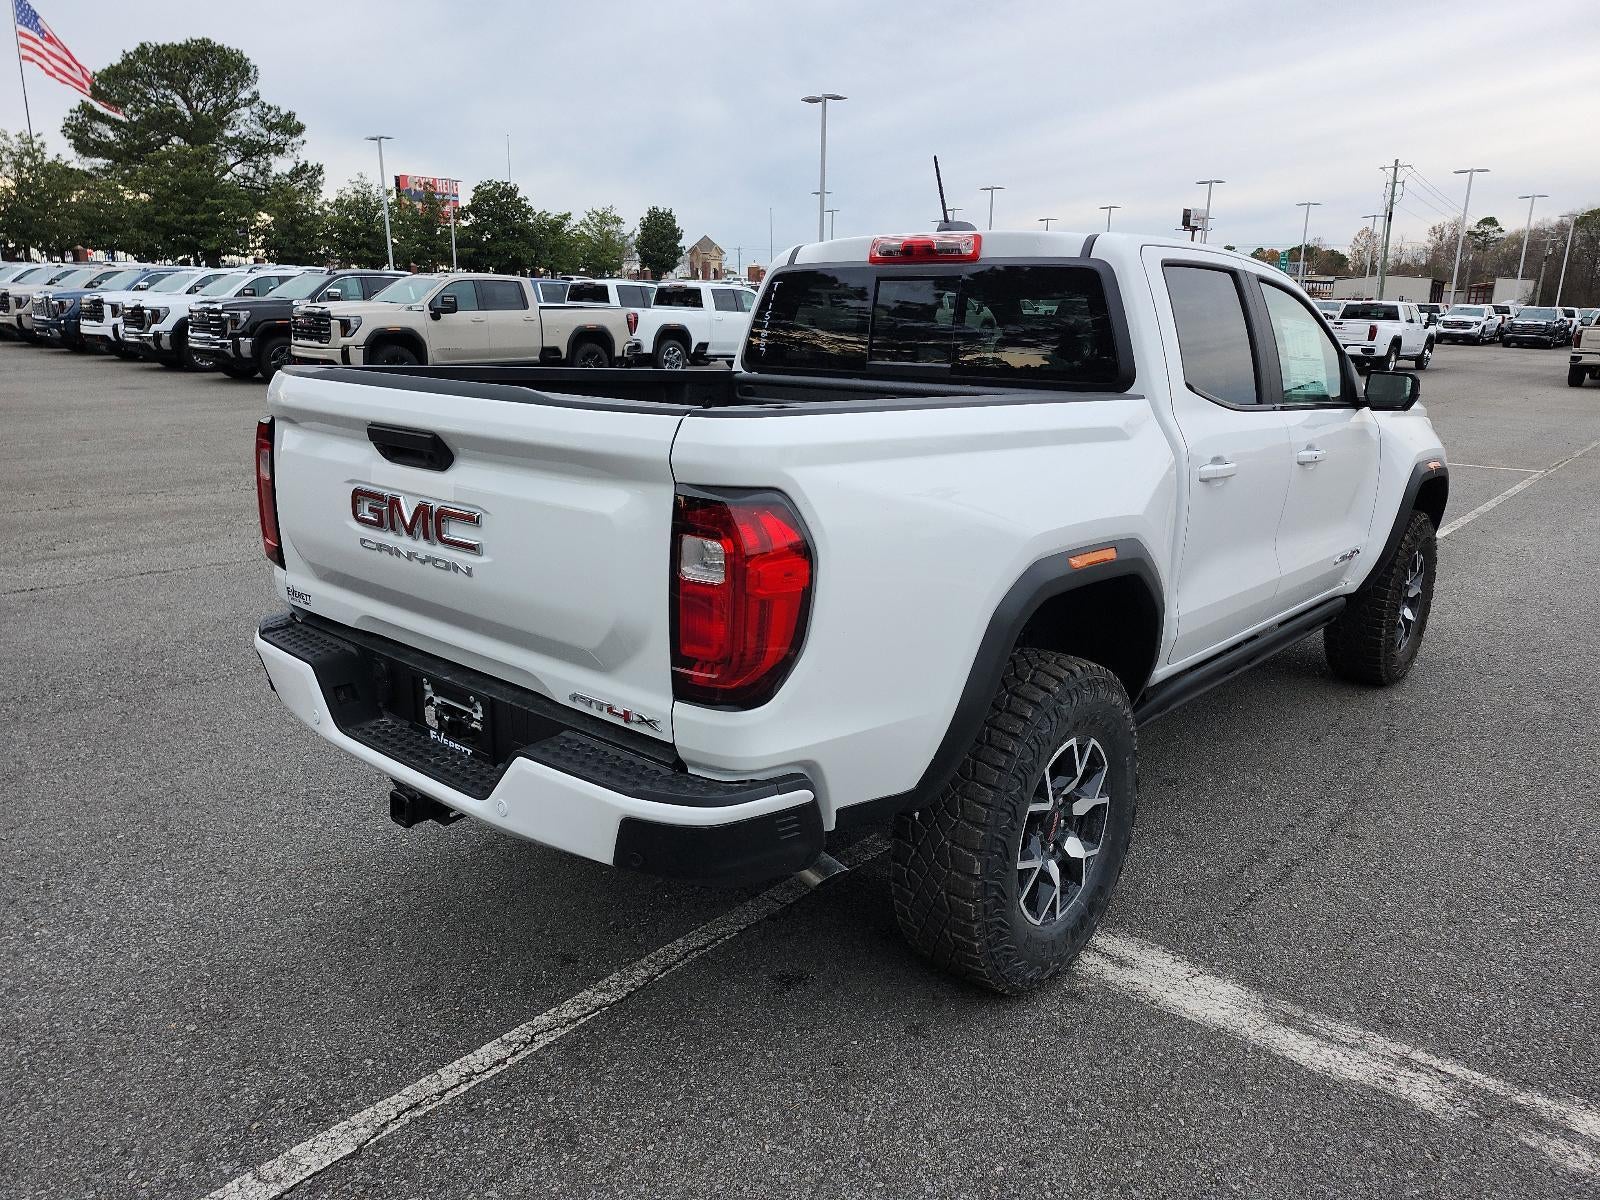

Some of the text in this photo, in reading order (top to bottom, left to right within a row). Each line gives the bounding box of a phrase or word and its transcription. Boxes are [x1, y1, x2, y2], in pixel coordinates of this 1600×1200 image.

[351, 486, 482, 557] GMC
[359, 537, 473, 577] CANYON
[568, 691, 662, 733] AT4X
[429, 730, 473, 756] EVERETT
